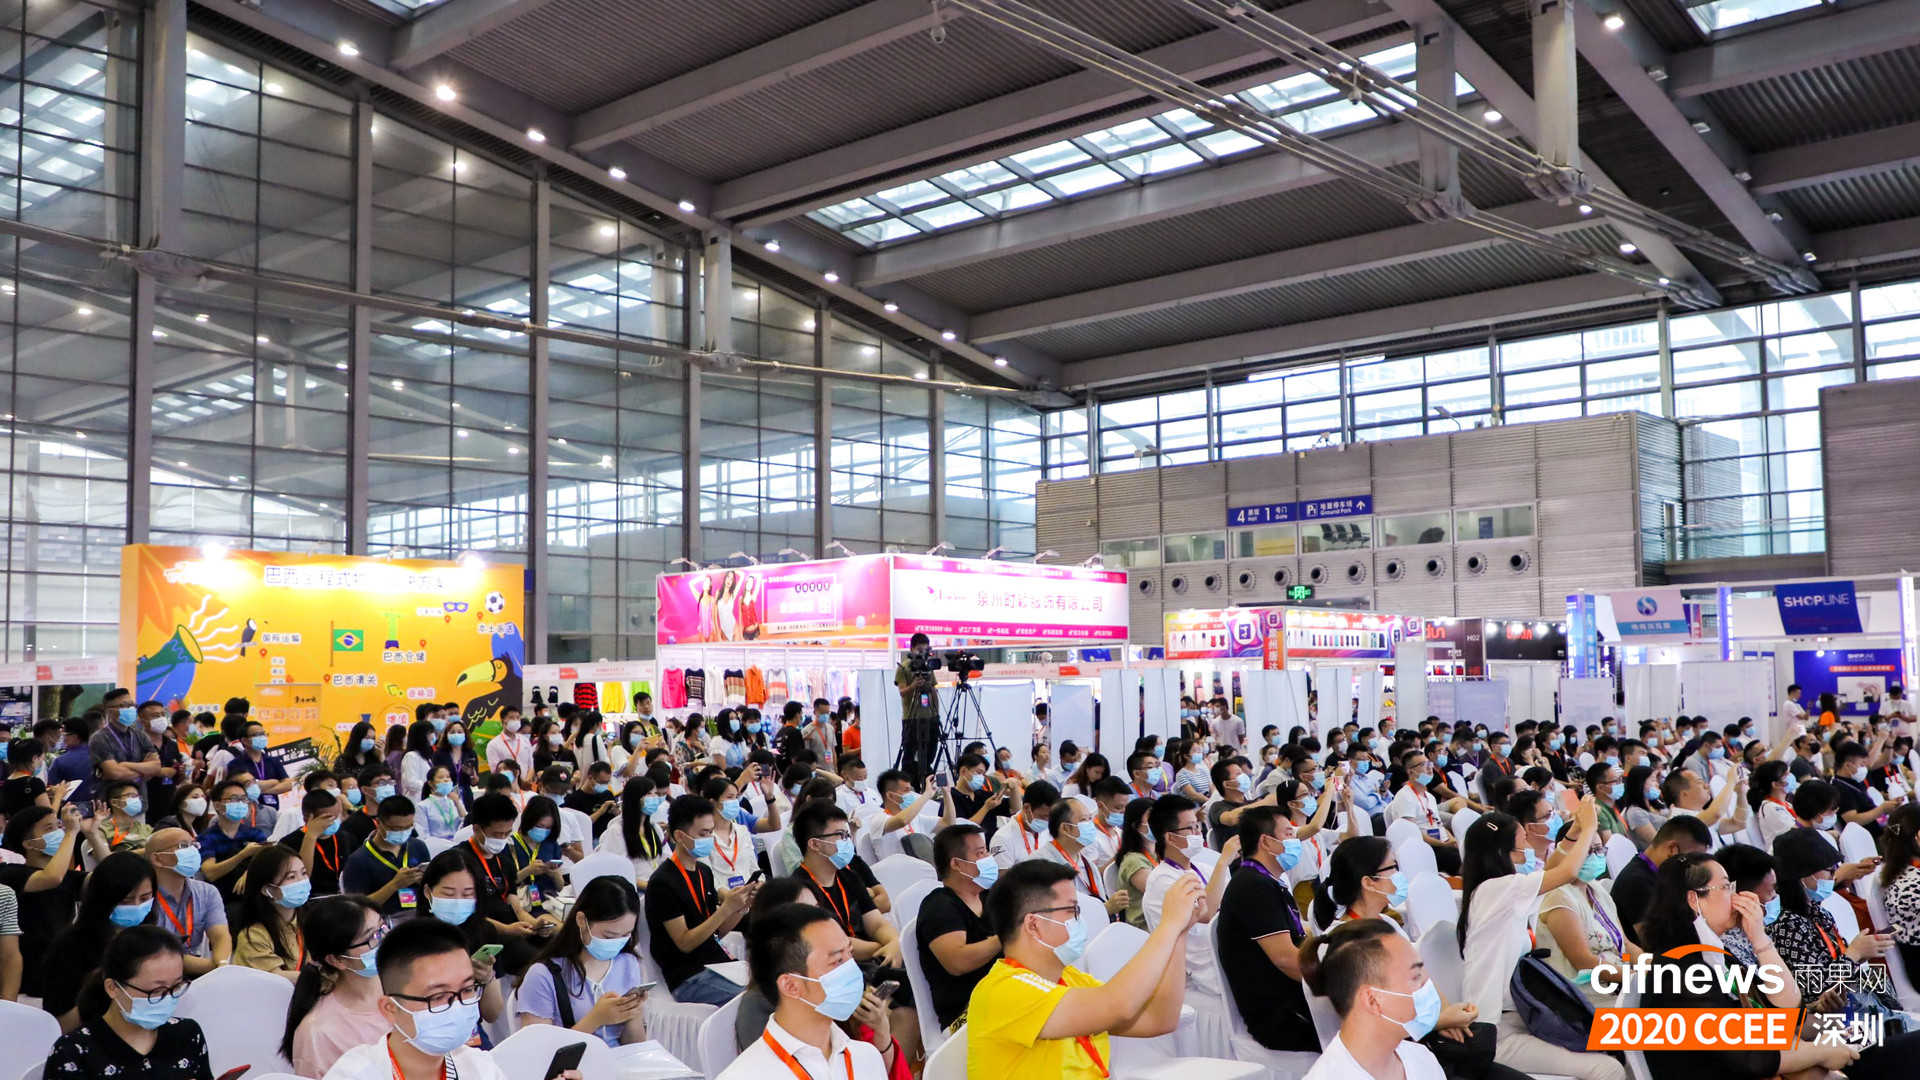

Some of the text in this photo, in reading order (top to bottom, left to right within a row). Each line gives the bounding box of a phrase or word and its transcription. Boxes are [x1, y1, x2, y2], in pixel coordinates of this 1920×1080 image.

[1237, 509, 1245, 523] 4
[1265, 507, 1270, 521] 1
[1783, 593, 1850, 608] SHOPLINE
[263, 634, 300, 642] 国际运输
[383, 651, 426, 662] 巴西仓储
[333, 675, 377, 685] 巴西清关
[387, 714, 407, 724] 增值
